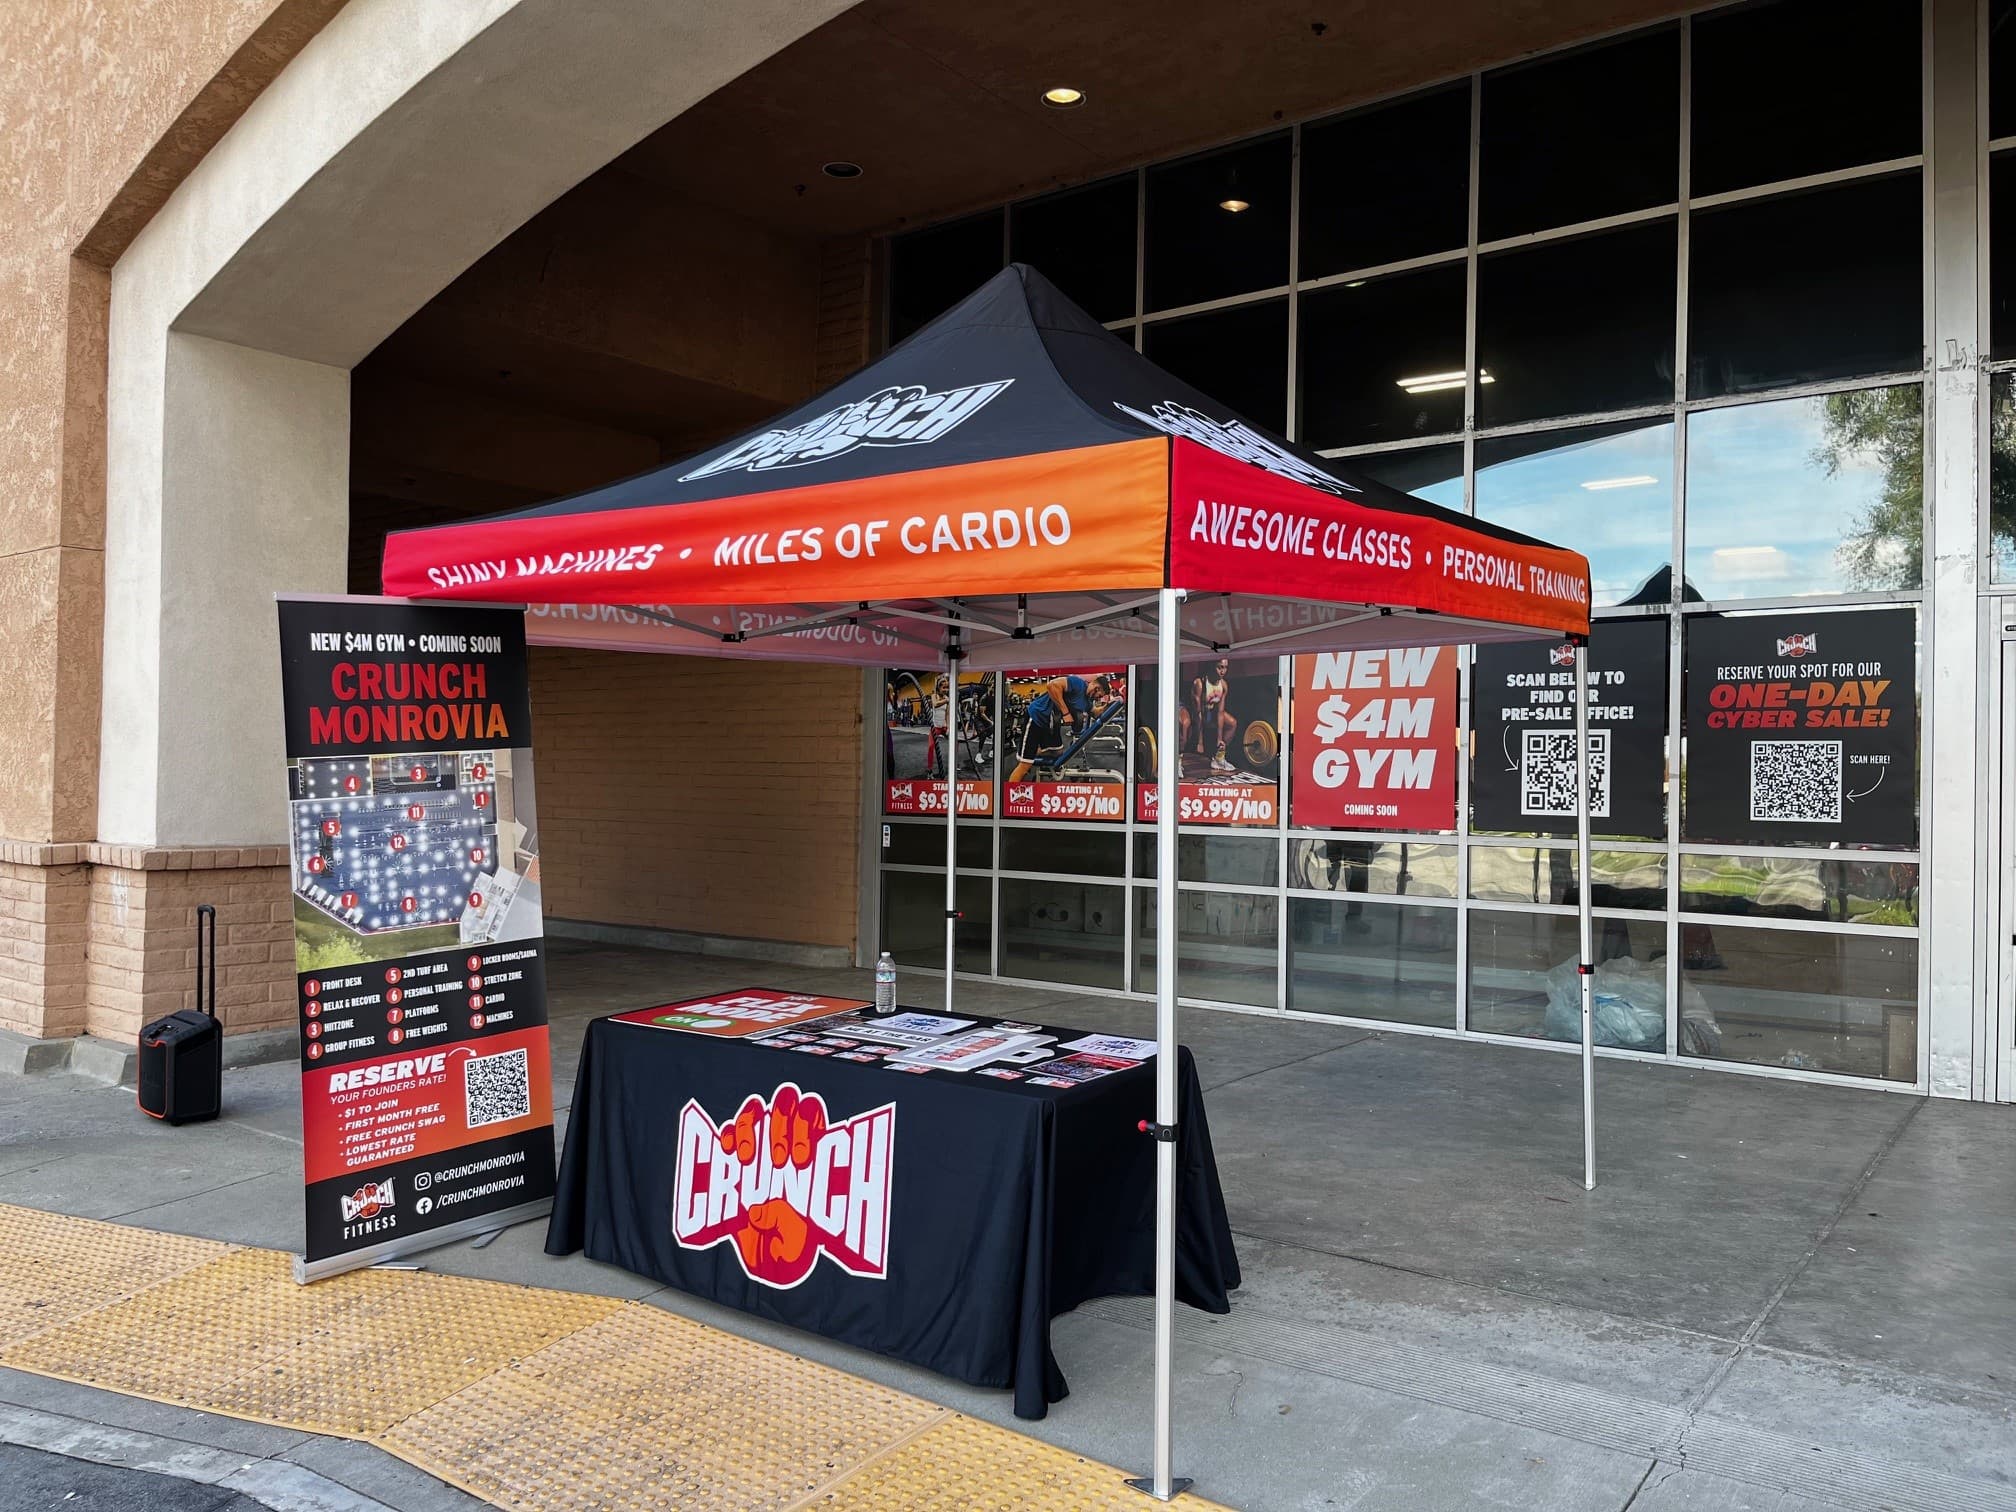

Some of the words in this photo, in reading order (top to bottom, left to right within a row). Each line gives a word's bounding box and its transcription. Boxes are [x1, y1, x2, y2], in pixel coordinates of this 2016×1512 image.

[714, 526, 823, 567] MILES
[835, 520, 889, 559] OF
[900, 504, 1071, 555] CARDIO
[1190, 500, 1320, 556] AWESOME
[1322, 521, 1411, 570] CLASSES
[1443, 545, 1525, 592] PERSONAL
[1529, 565, 1586, 604] TRAINING
[311, 633, 341, 651] NEW
[345, 632, 372, 653] $4M
[376, 634, 405, 652] GYM
[420, 635, 466, 652] COMING
[470, 636, 501, 653] SOON
[1311, 646, 1441, 690] NEW
[1717, 665, 1763, 680] RESERVE
[1767, 664, 1796, 679] YOUR
[1800, 663, 1828, 678] SPOT
[1832, 662, 1853, 677] FOR
[1857, 662, 1881, 677] OUR
[331, 662, 486, 701] CRUNCH
[1506, 673, 1545, 687] SCAN
[1550, 672, 1600, 687] BELW
[1604, 671, 1625, 685] TO
[1530, 690, 1564, 704] FIND
[1568, 689, 1599, 703] OR
[1709, 680, 1891, 709] ONE-DAY
[1312, 694, 1435, 744] $4M
[1502, 707, 1572, 721] PRE-SALE
[1588, 706, 1634, 720] FFICE!
[1707, 710, 1797, 729] CYBER
[1805, 709, 1891, 728] SALE!
[309, 704, 509, 745] MONROVIA
[1312, 749, 1437, 789] GYM
[1850, 755, 1868, 764] SCAN
[1870, 755, 1890, 764] HERE!
[965, 783, 974, 791] AT
[1056, 785, 1091, 794] STARTING
[1093, 786, 1103, 795] AT
[1198, 788, 1239, 797] STARTING
[1241, 789, 1253, 798] AT
[891, 802, 913, 810] FITNESS
[919, 791, 989, 812] $9.9/MO
[1009, 806, 1034, 814] FITNESS
[1041, 794, 1120, 816] $9.99/MO
[1180, 797, 1272, 821] $9.99/MO
[1344, 803, 1374, 816] COMING
[1376, 804, 1398, 817] SOON
[483, 954, 501, 965] LOCKER
[403, 968, 415, 979] 2ND
[416, 965, 431, 976] TURF
[432, 963, 448, 974] AREA
[471, 977, 480, 988] 10
[484, 973, 508, 986] STRETCH
[508, 970, 523, 981] ZONE
[322, 981, 344, 991] FRONT
[345, 977, 362, 987] DESK
[403, 985, 434, 999] PERSONAL
[434, 980, 463, 993] TRAINING
[323, 1000, 344, 1011] RELAX
[351, 994, 380, 1007] RECOVER
[473, 996, 481, 1007] 11
[485, 992, 505, 1004] CARDIO
[717, 996, 829, 1015] FLEX
[404, 1004, 439, 1019] PLATFORMS
[473, 1015, 482, 1027] 12
[486, 1010, 514, 1024] MACHINES
[674, 1003, 800, 1023] MODE
[405, 1027, 421, 1039] FREE
[422, 1022, 448, 1036] WEIGHTS
[325, 1041, 347, 1053] GROUP
[349, 1036, 375, 1049] FITNESS
[329, 1053, 447, 1094] RESERVE
[331, 1091, 360, 1105] YOUR
[362, 1080, 416, 1099] FOUNDERS
[418, 1074, 447, 1087] RATE!
[344, 1108, 356, 1118] $1
[359, 1104, 371, 1114] TO
[374, 1098, 399, 1111] JOIN
[345, 1117, 375, 1131] FIRST
[377, 1109, 413, 1124] MONTH
[415, 1103, 440, 1116] FREE
[345, 1131, 372, 1144] FREE
[374, 1121, 415, 1137] CRUNCH
[417, 1115, 446, 1128] SWAG
[346, 1139, 387, 1156] LOWEST
[389, 1133, 416, 1145] RATE
[346, 1144, 414, 1167] GUARANTEED
[434, 1150, 525, 1183] @CRUNCHMONROVIA
[437, 1175, 524, 1209] /CRUNCHMONROVIA
[672, 1097, 896, 1280] CRUNCH
[341, 1177, 395, 1221] CRUNCH
[344, 1215, 397, 1240] FITNESS
